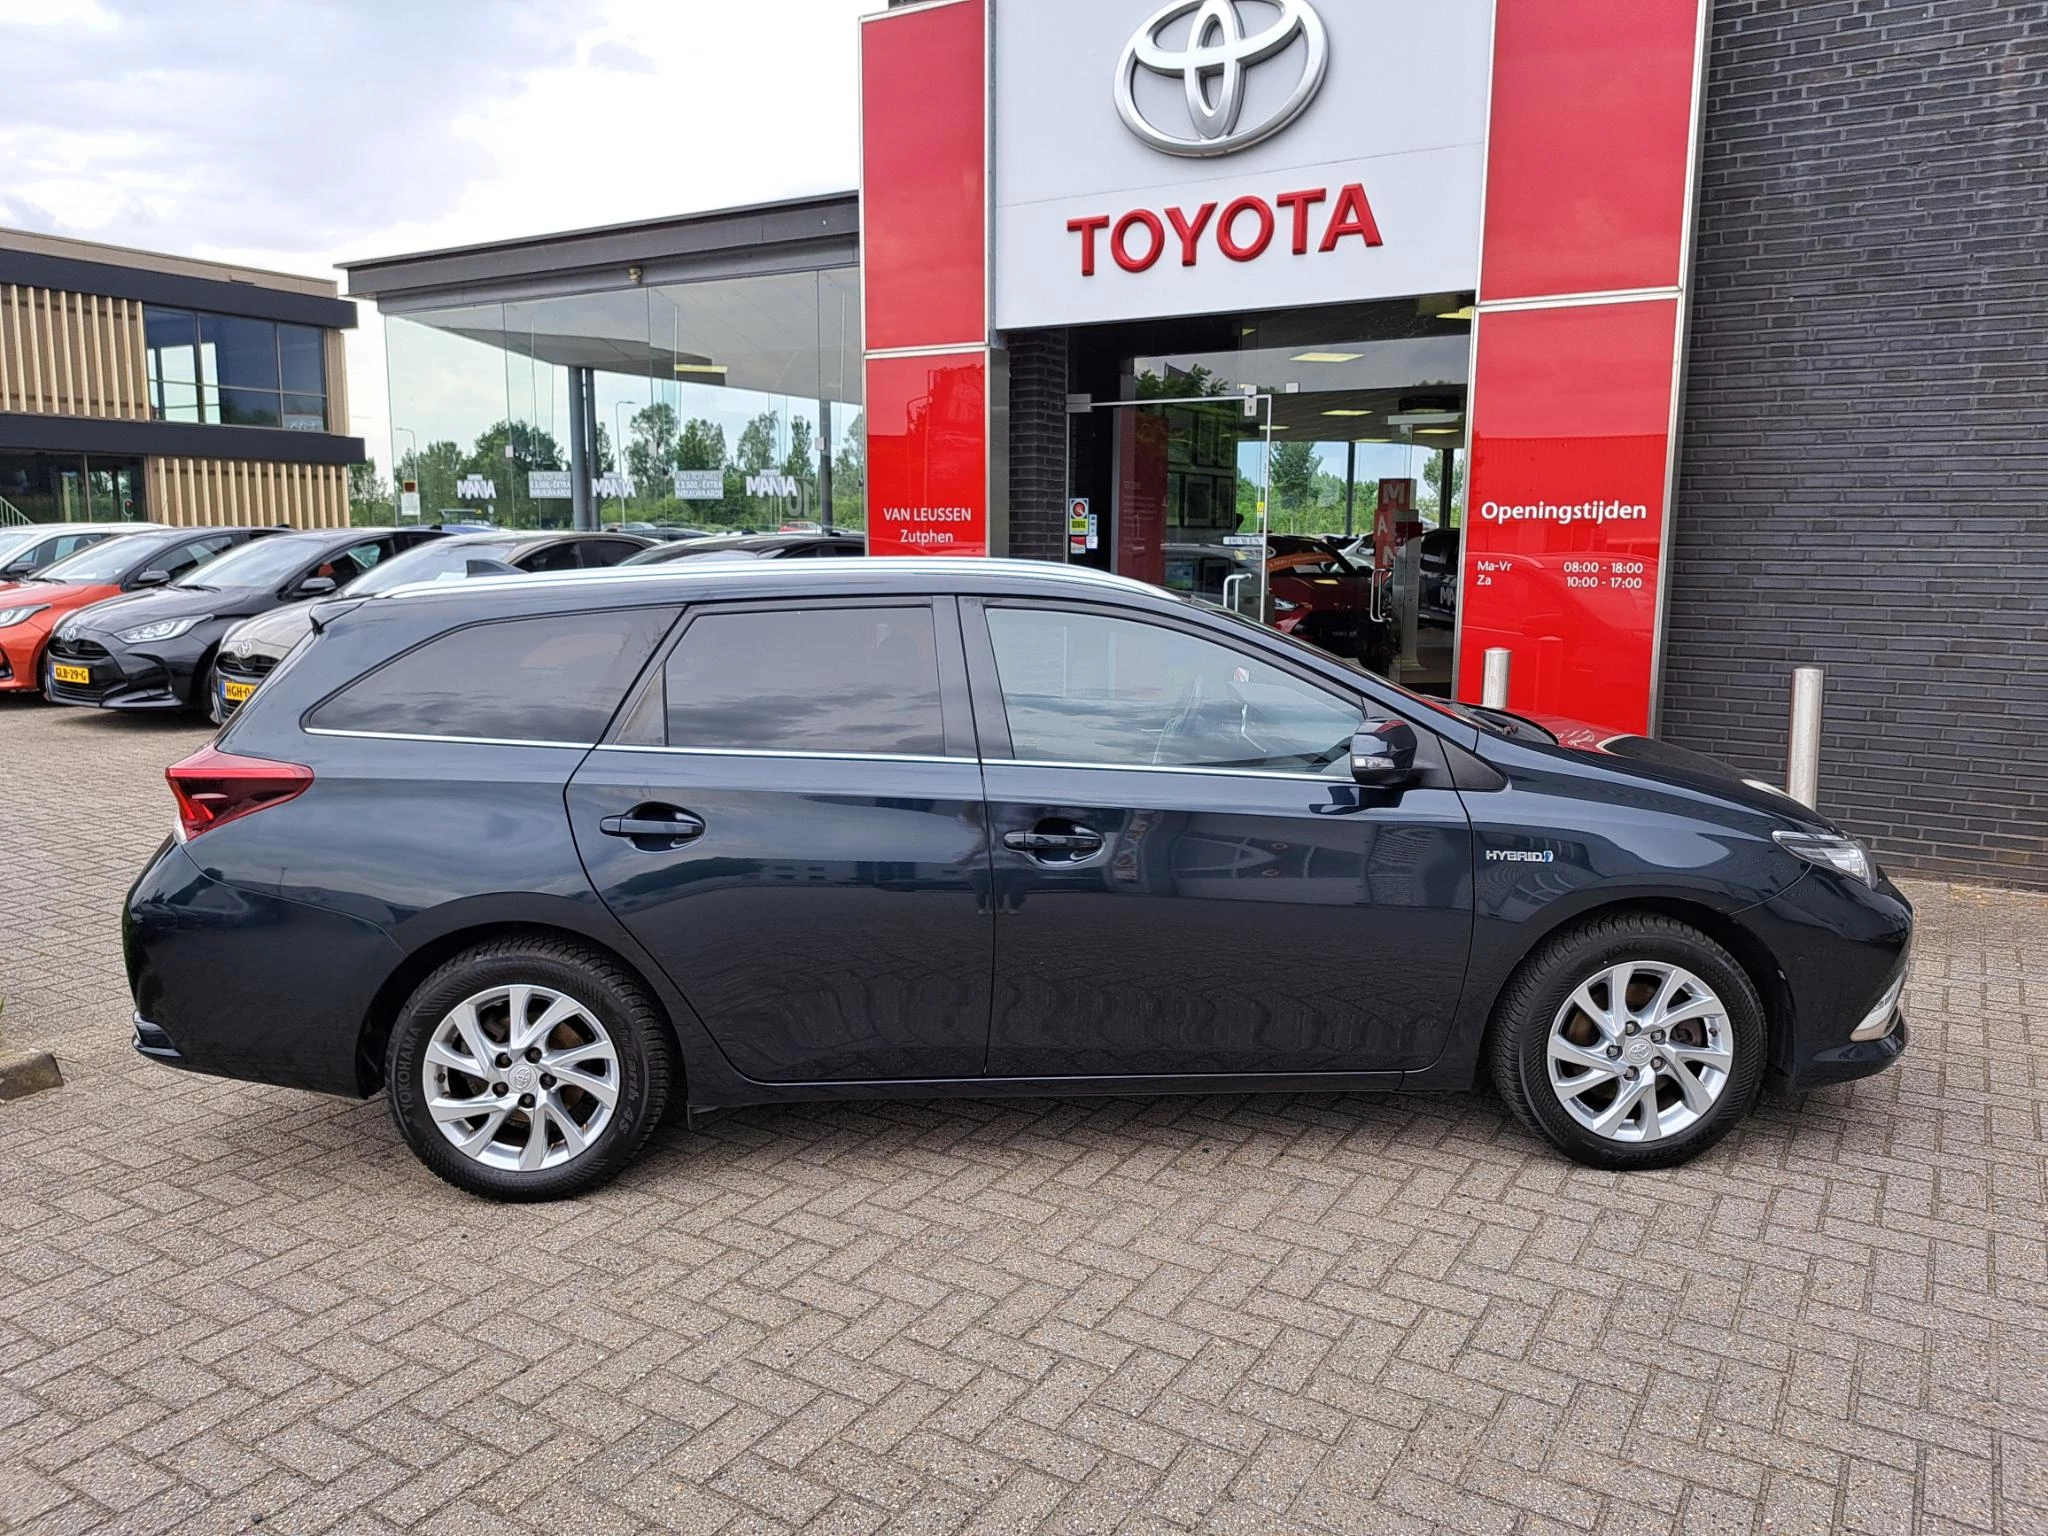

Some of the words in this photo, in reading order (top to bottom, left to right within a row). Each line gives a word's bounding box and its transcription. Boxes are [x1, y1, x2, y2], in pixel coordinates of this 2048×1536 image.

[1066, 183, 1383, 277] TOYOTA
[456, 479, 497, 499] MANIA
[591, 478, 637, 498] MANIA
[745, 475, 799, 498] MANIA
[883, 507, 910, 521] VAN
[913, 507, 972, 521] LEUSSEN
[1481, 501, 1647, 524] Openingstijden
[900, 529, 954, 546] Zutphen
[1477, 561, 1512, 572] Ma-Vr
[1563, 561, 1599, 573] 08:00
[1611, 562, 1644, 574] 18:00
[1477, 575, 1491, 585] Za
[1567, 576, 1599, 588] 10:00
[1610, 577, 1642, 589] 17:00
[1486, 850, 1543, 862] HYBRID
[398, 1027, 422, 1110] YOKOHAMA
